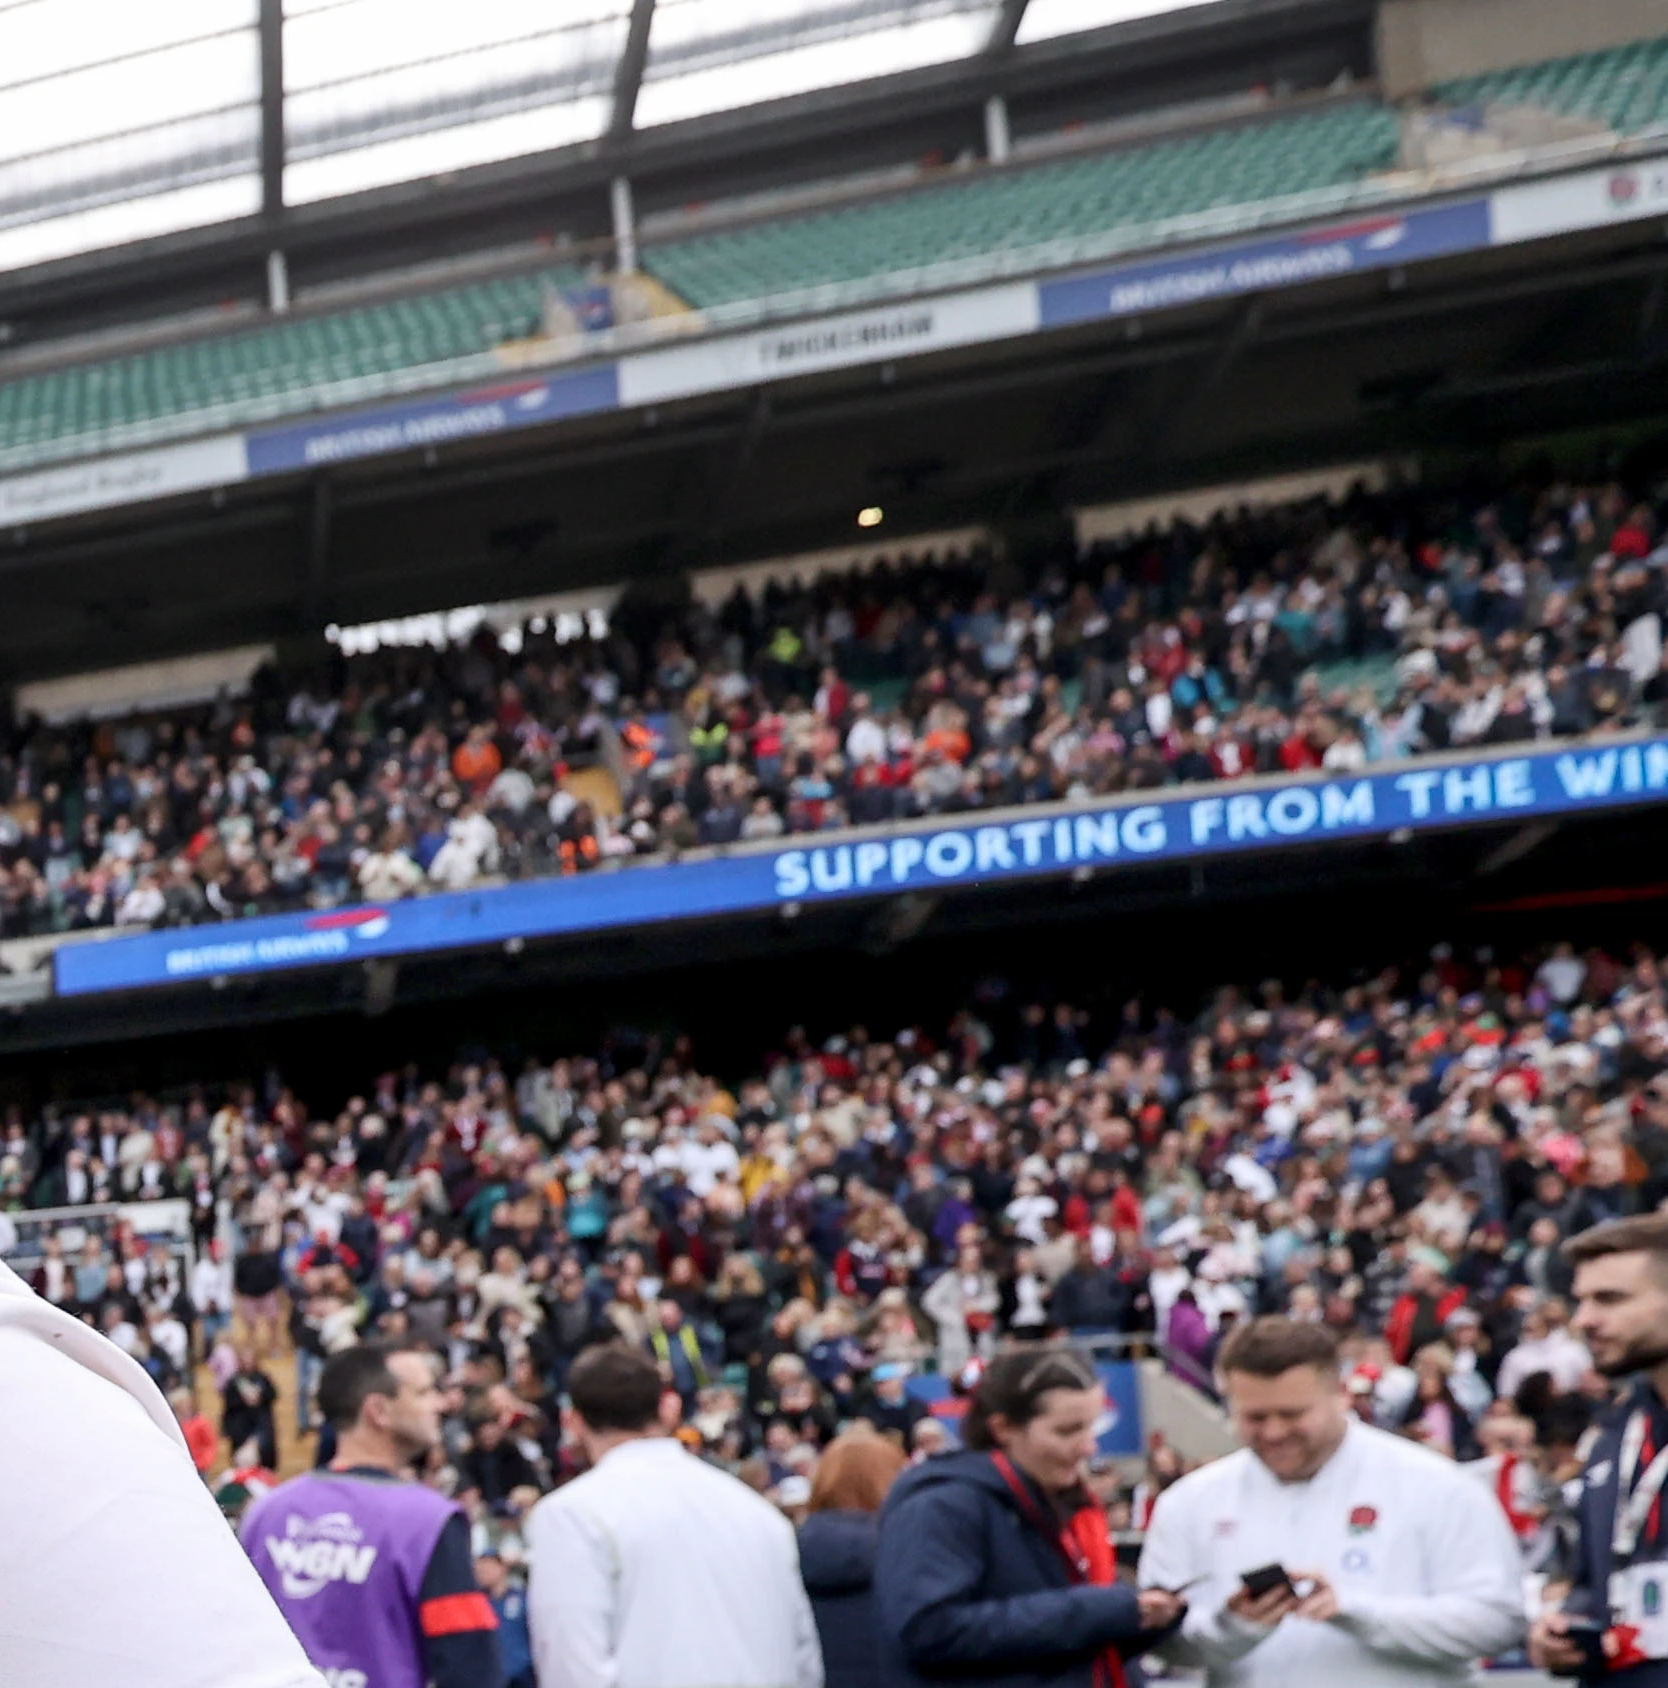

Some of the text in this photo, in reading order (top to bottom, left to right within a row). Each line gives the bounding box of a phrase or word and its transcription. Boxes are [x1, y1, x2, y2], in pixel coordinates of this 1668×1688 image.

[774, 805, 1168, 897] SUPPORTING
[1189, 779, 1375, 845] FROM
[1394, 758, 1536, 819] THE
